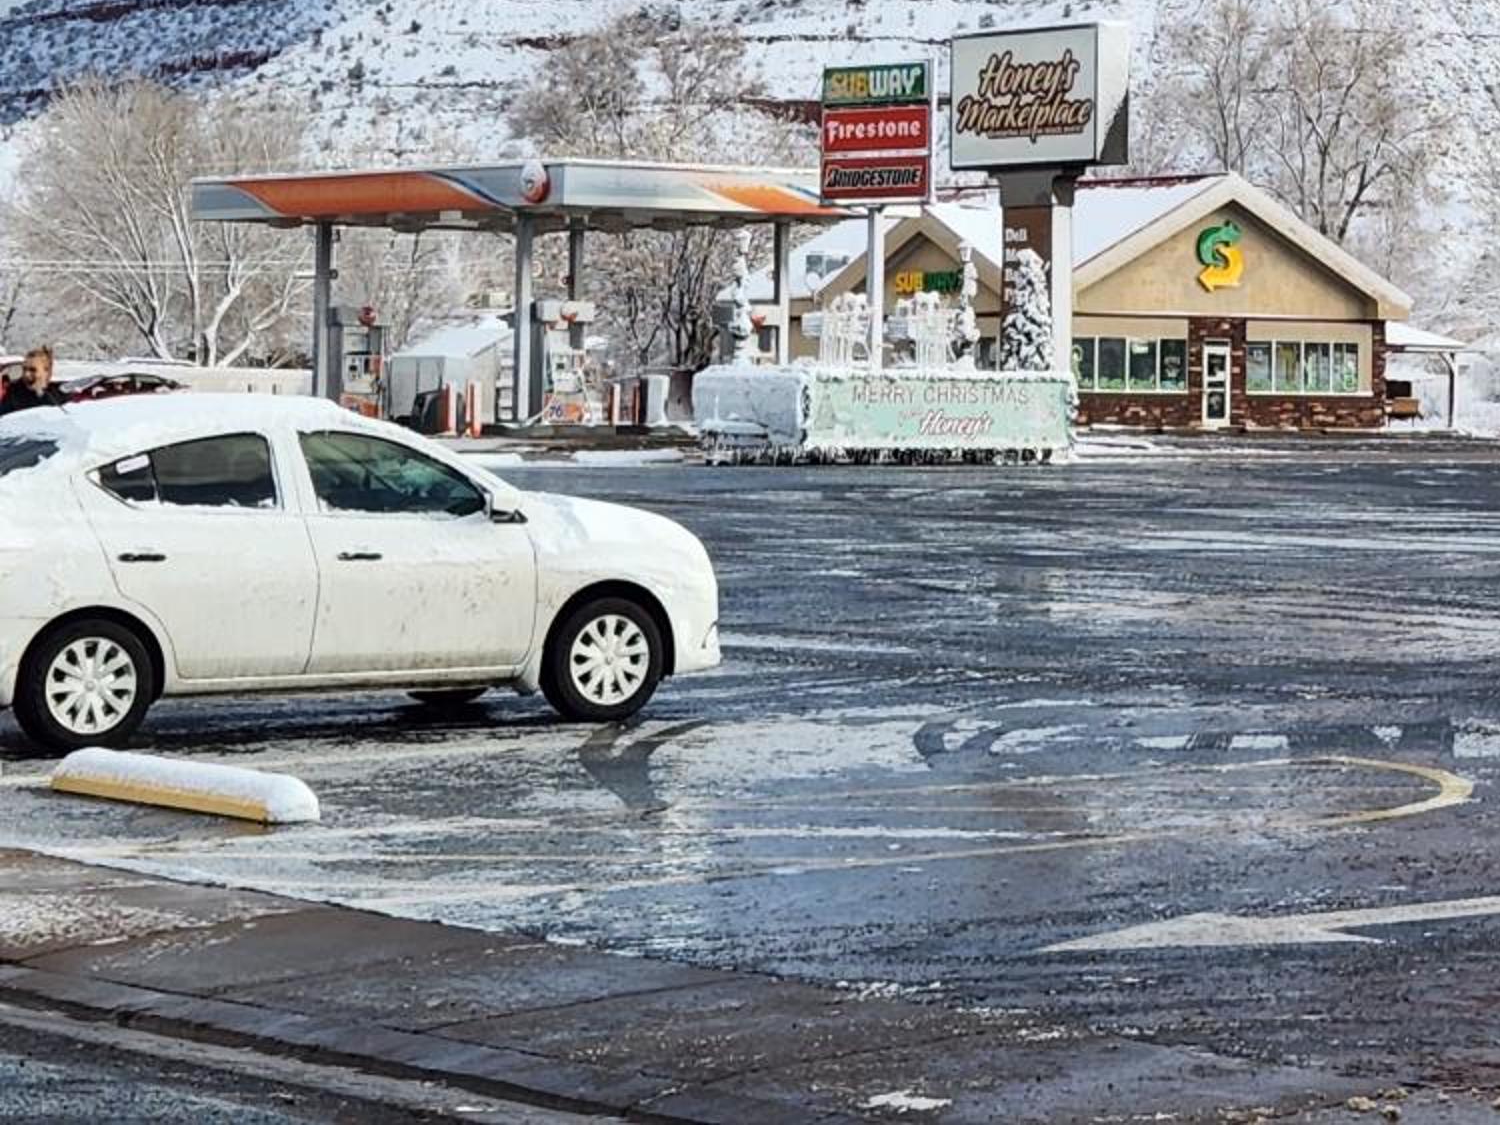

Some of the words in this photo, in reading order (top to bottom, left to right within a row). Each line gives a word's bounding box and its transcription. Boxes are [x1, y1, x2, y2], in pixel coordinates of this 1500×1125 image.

[831, 67, 922, 99] SUBWAY
[977, 48, 1080, 99] Honey's
[826, 119, 921, 145] Firestone
[956, 91, 1093, 144] Marketplace
[826, 166, 921, 189] BRIDGESTONE
[853, 386, 915, 404] MERRY
[923, 385, 1029, 404] CHRISTMAS
[919, 408, 995, 441] Honey's
